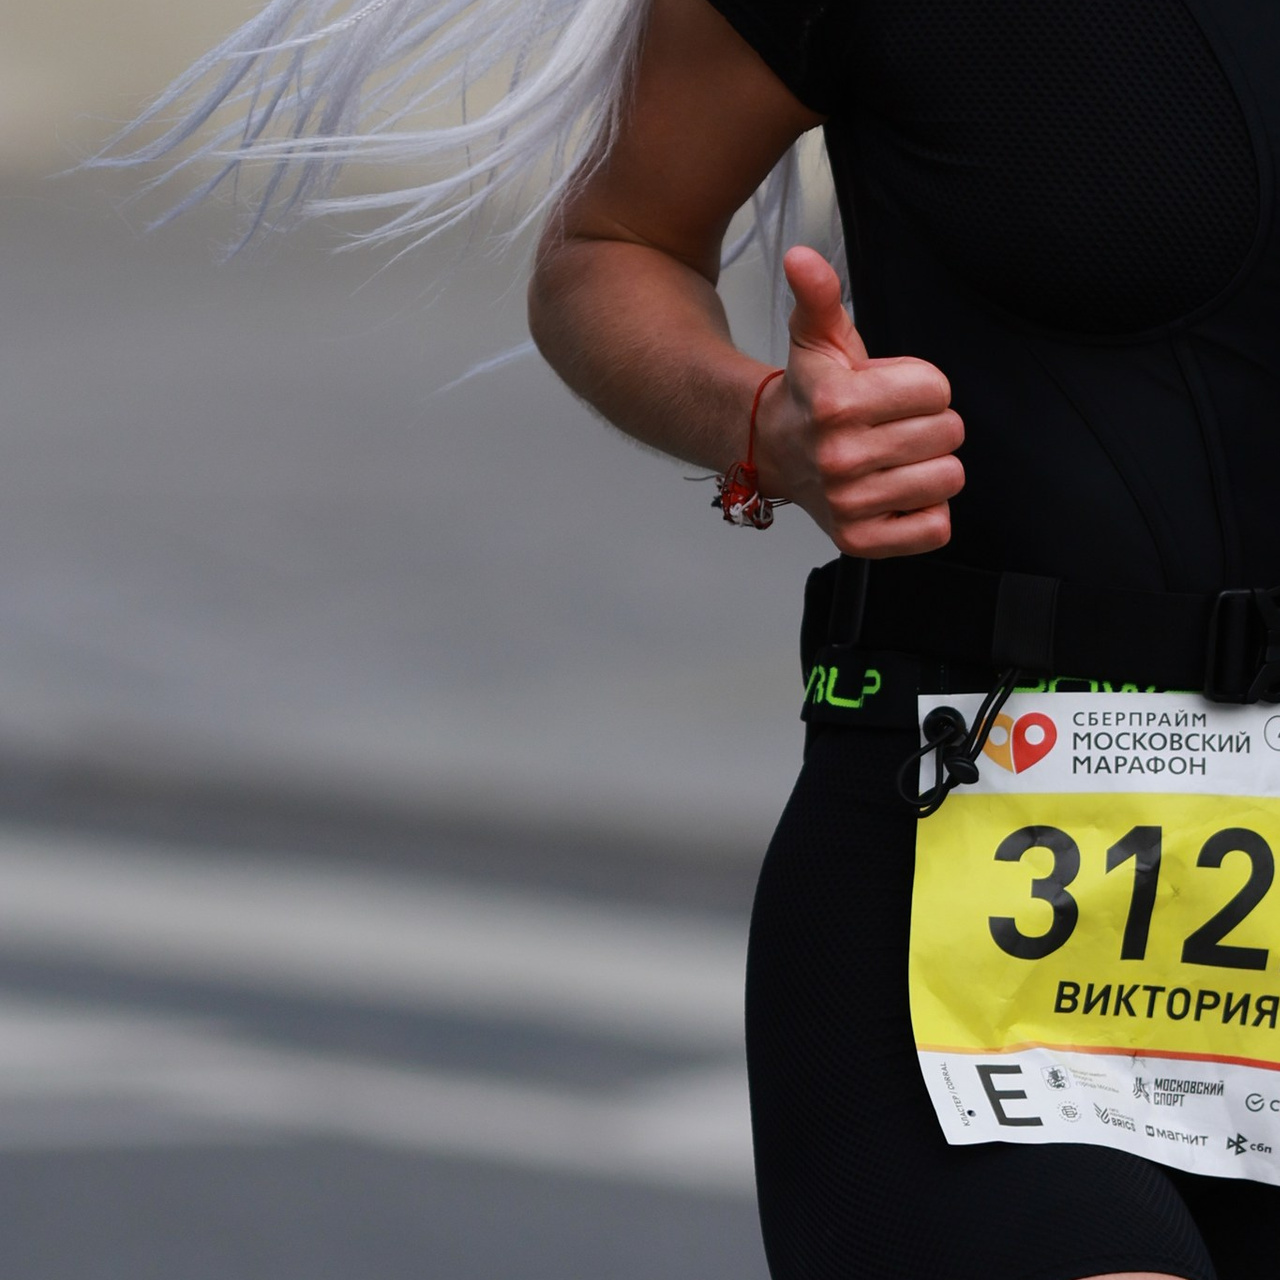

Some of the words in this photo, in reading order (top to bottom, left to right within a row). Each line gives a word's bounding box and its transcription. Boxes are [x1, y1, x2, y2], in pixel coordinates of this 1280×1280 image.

[1072, 709, 1207, 728] СБЕРПРАЙМ
[1072, 731, 1251, 754] МОСКОВСКИЙ
[1072, 755, 1207, 776] МАРАФОН
[1053, 980, 1280, 1030] ВИКТОРИЯ
[1153, 1078, 1225, 1097] МОСКОВСКИЙ
[1153, 1091, 1186, 1107] СПОРТ
[1249, 1142, 1272, 1154] сбп
